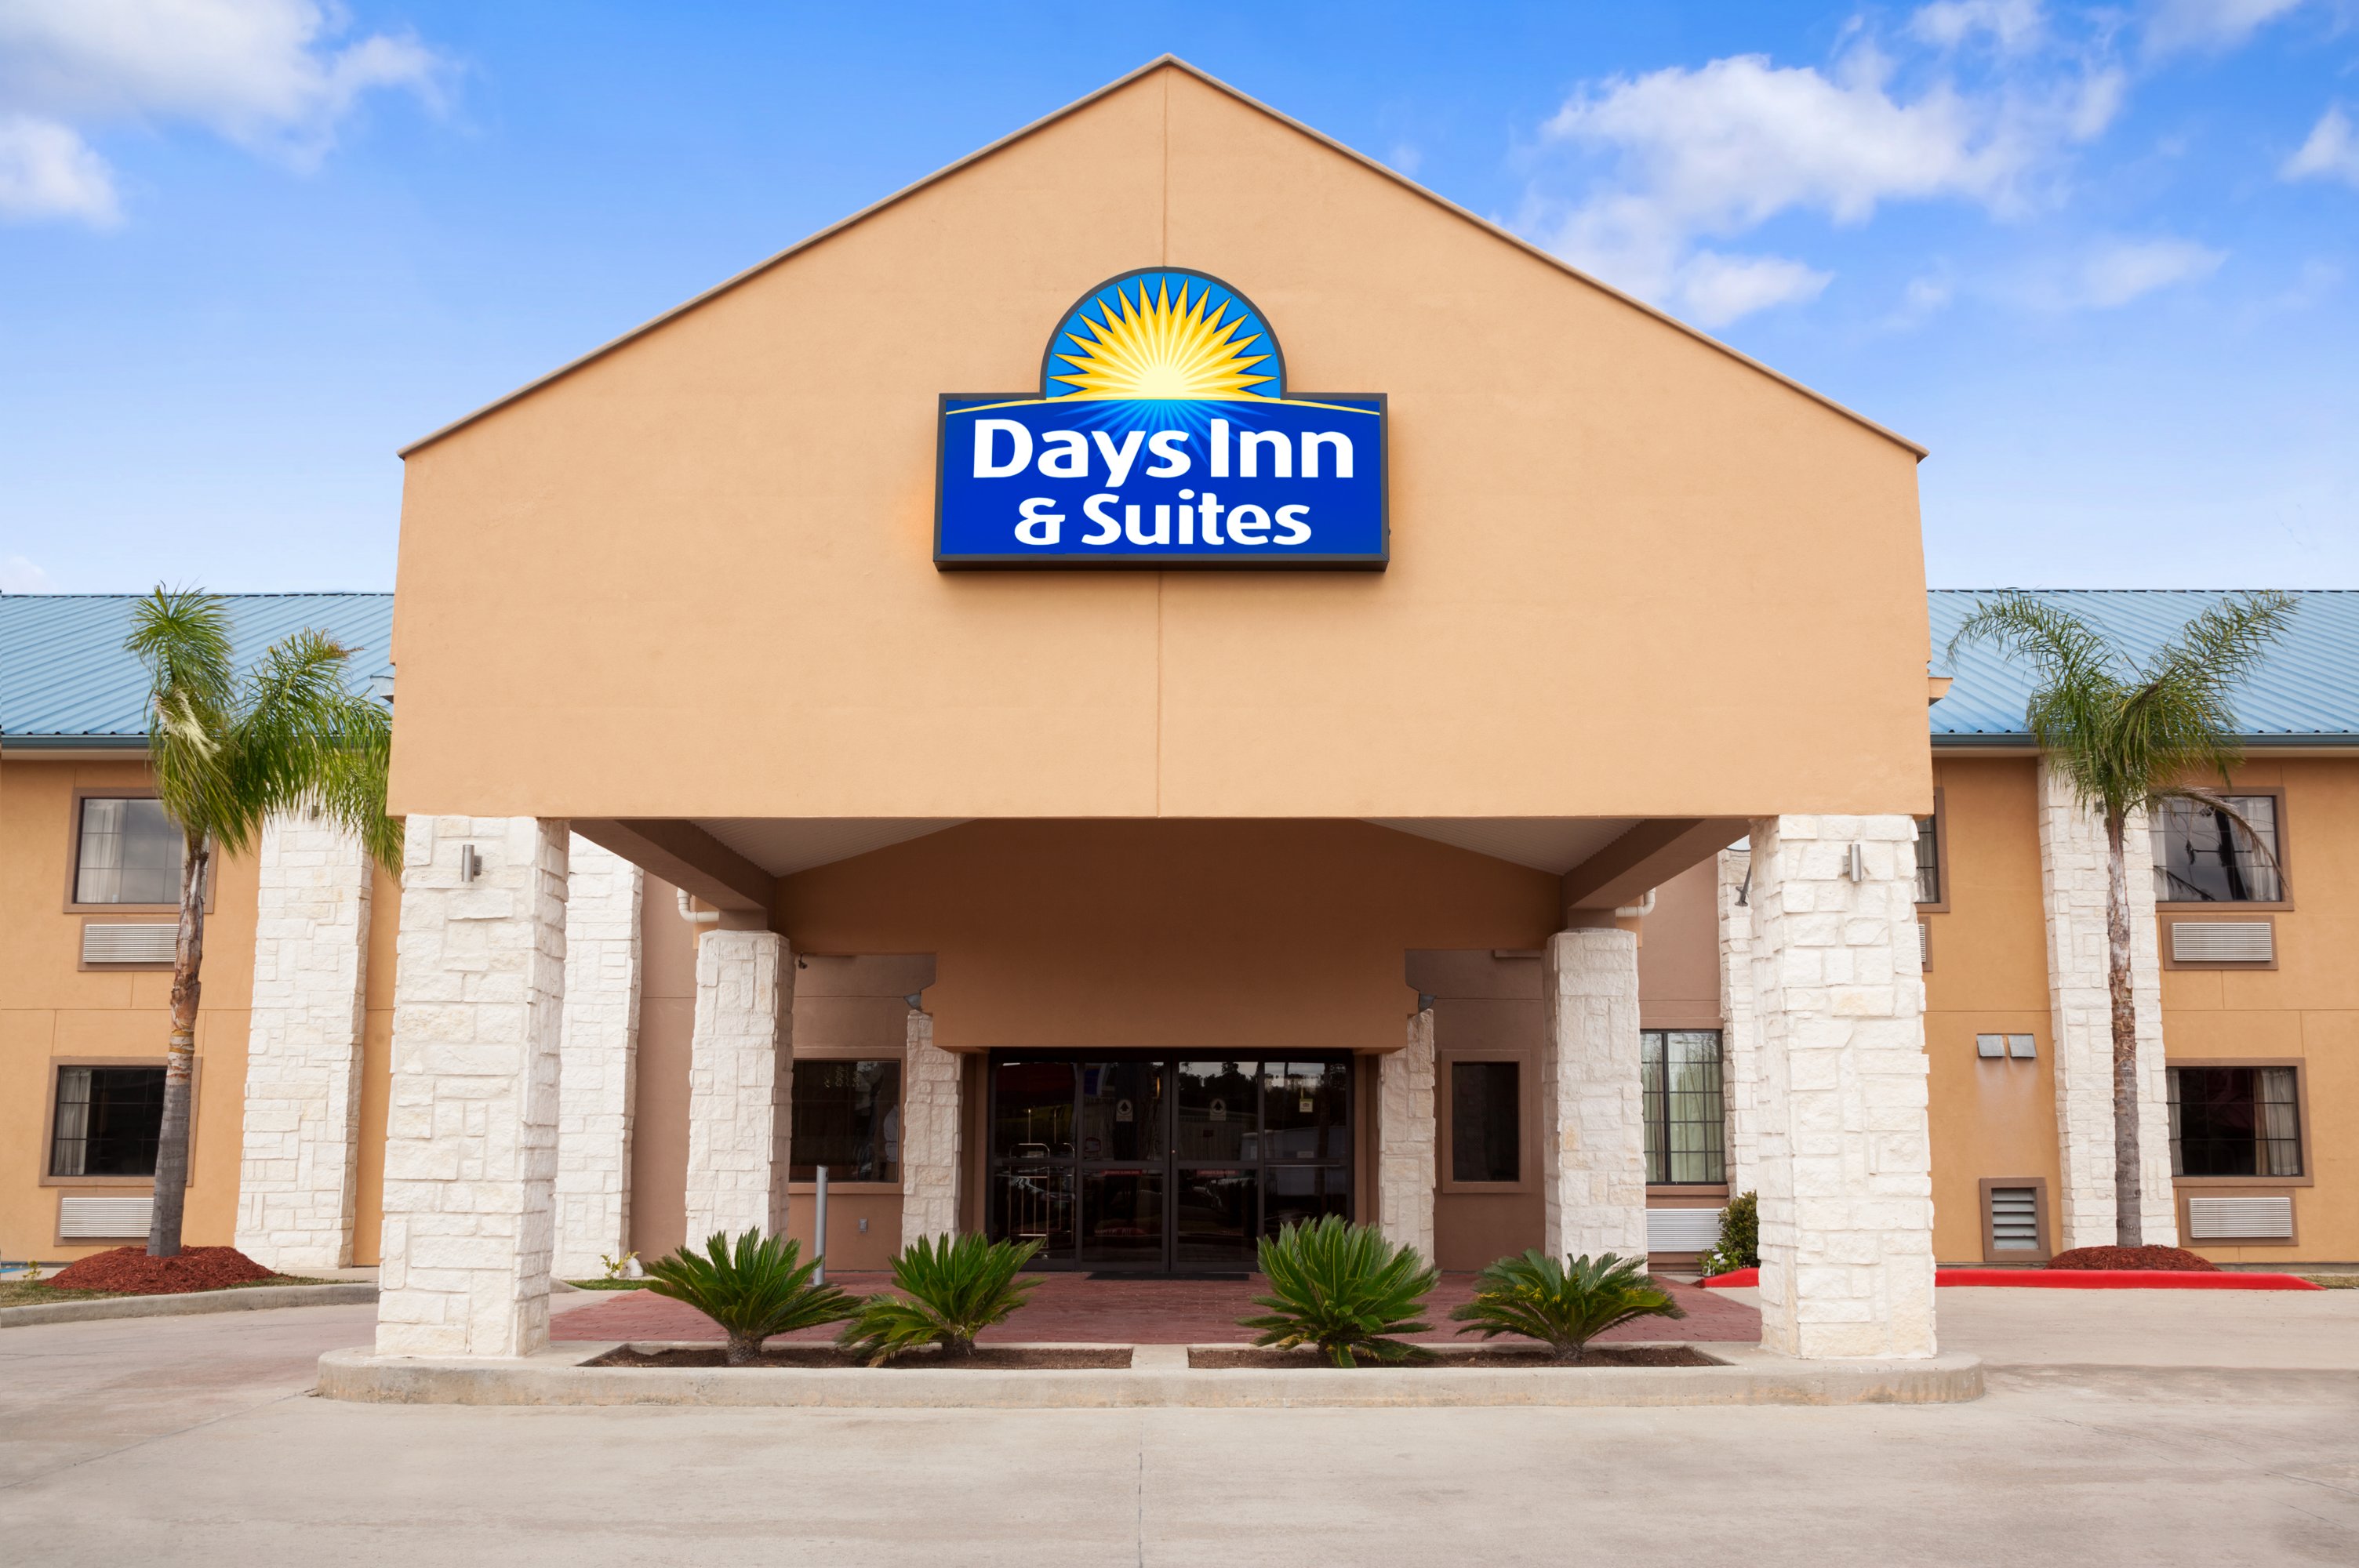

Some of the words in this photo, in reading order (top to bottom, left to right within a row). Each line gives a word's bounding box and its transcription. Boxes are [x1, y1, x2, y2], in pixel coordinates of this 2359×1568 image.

[973, 419, 1191, 487] Days
[1210, 418, 1354, 477] Inn
[1014, 497, 1066, 546] &
[1081, 488, 1312, 546] Suites
